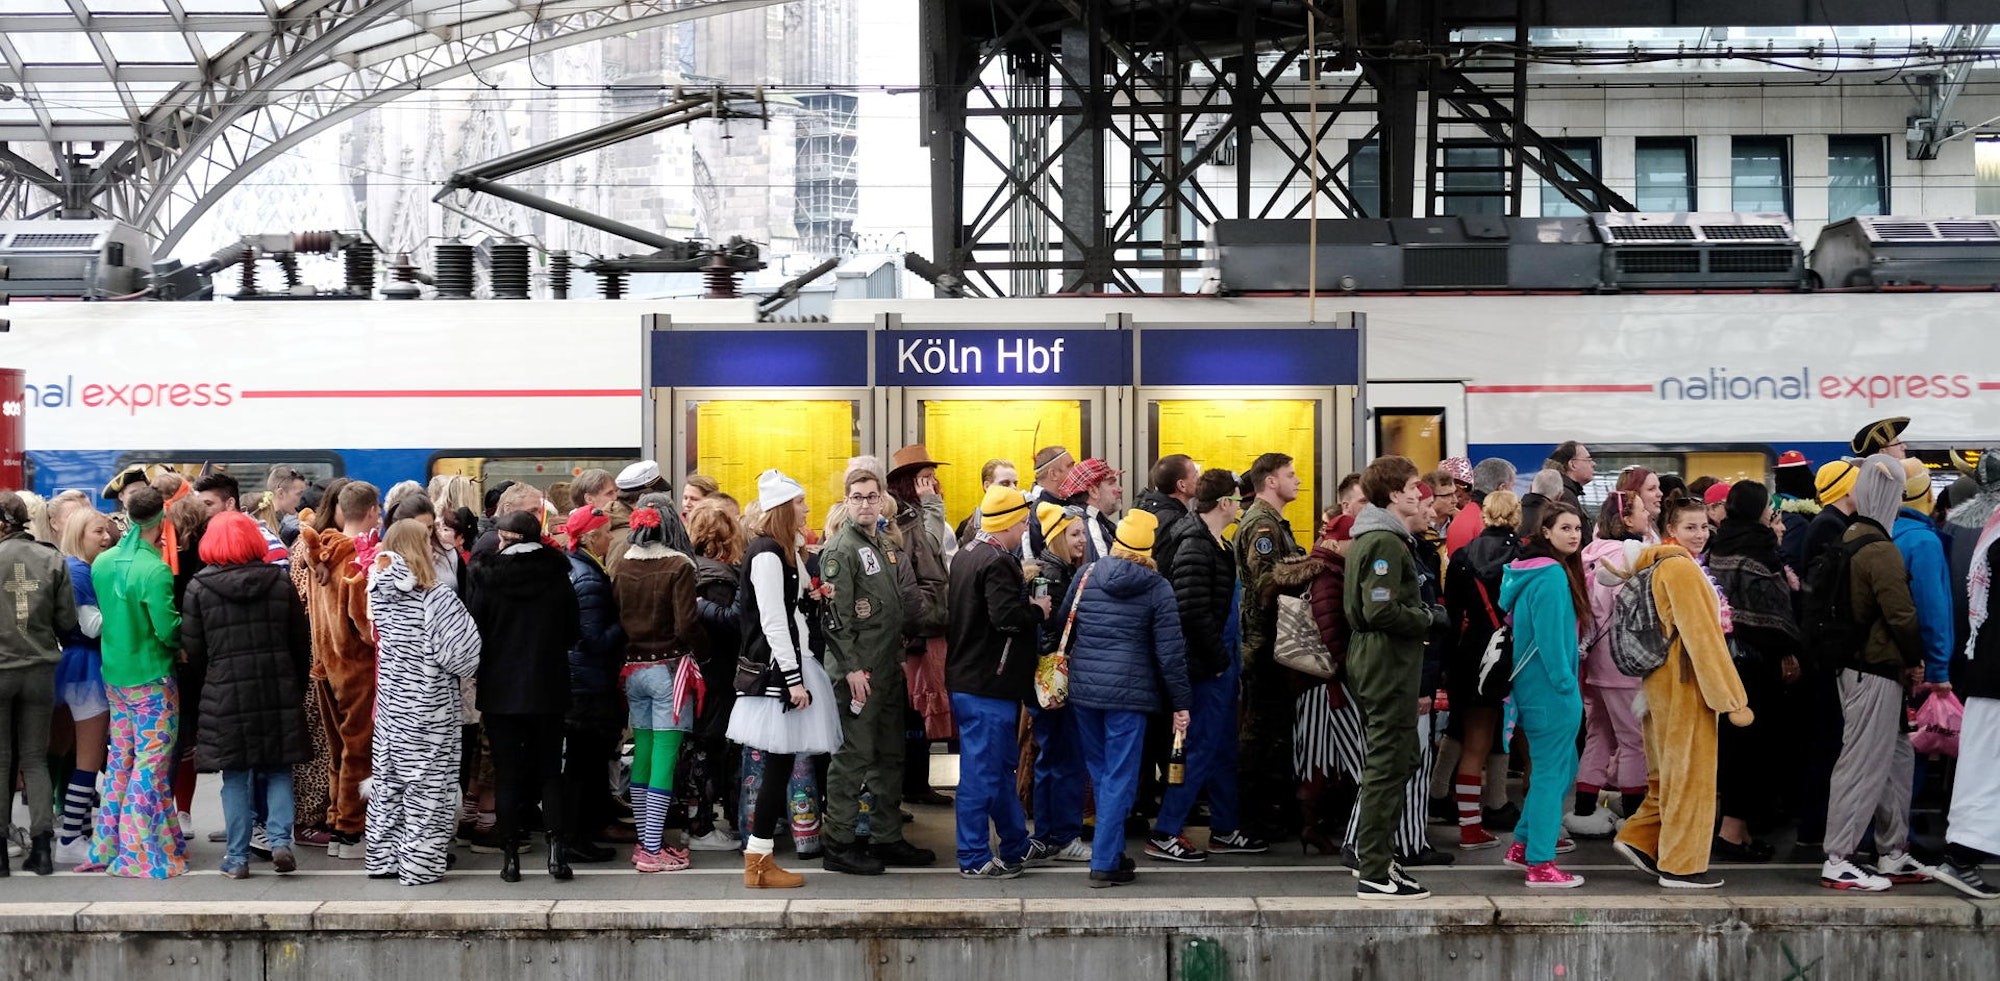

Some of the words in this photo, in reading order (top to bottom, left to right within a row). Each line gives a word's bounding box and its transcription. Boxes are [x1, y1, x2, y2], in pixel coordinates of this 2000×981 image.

[898, 338, 982, 374] Köln
[998, 338, 1065, 374] Hbf
[82, 383, 233, 417] express
[1660, 367, 1810, 401] national
[1818, 374, 1971, 409] express
